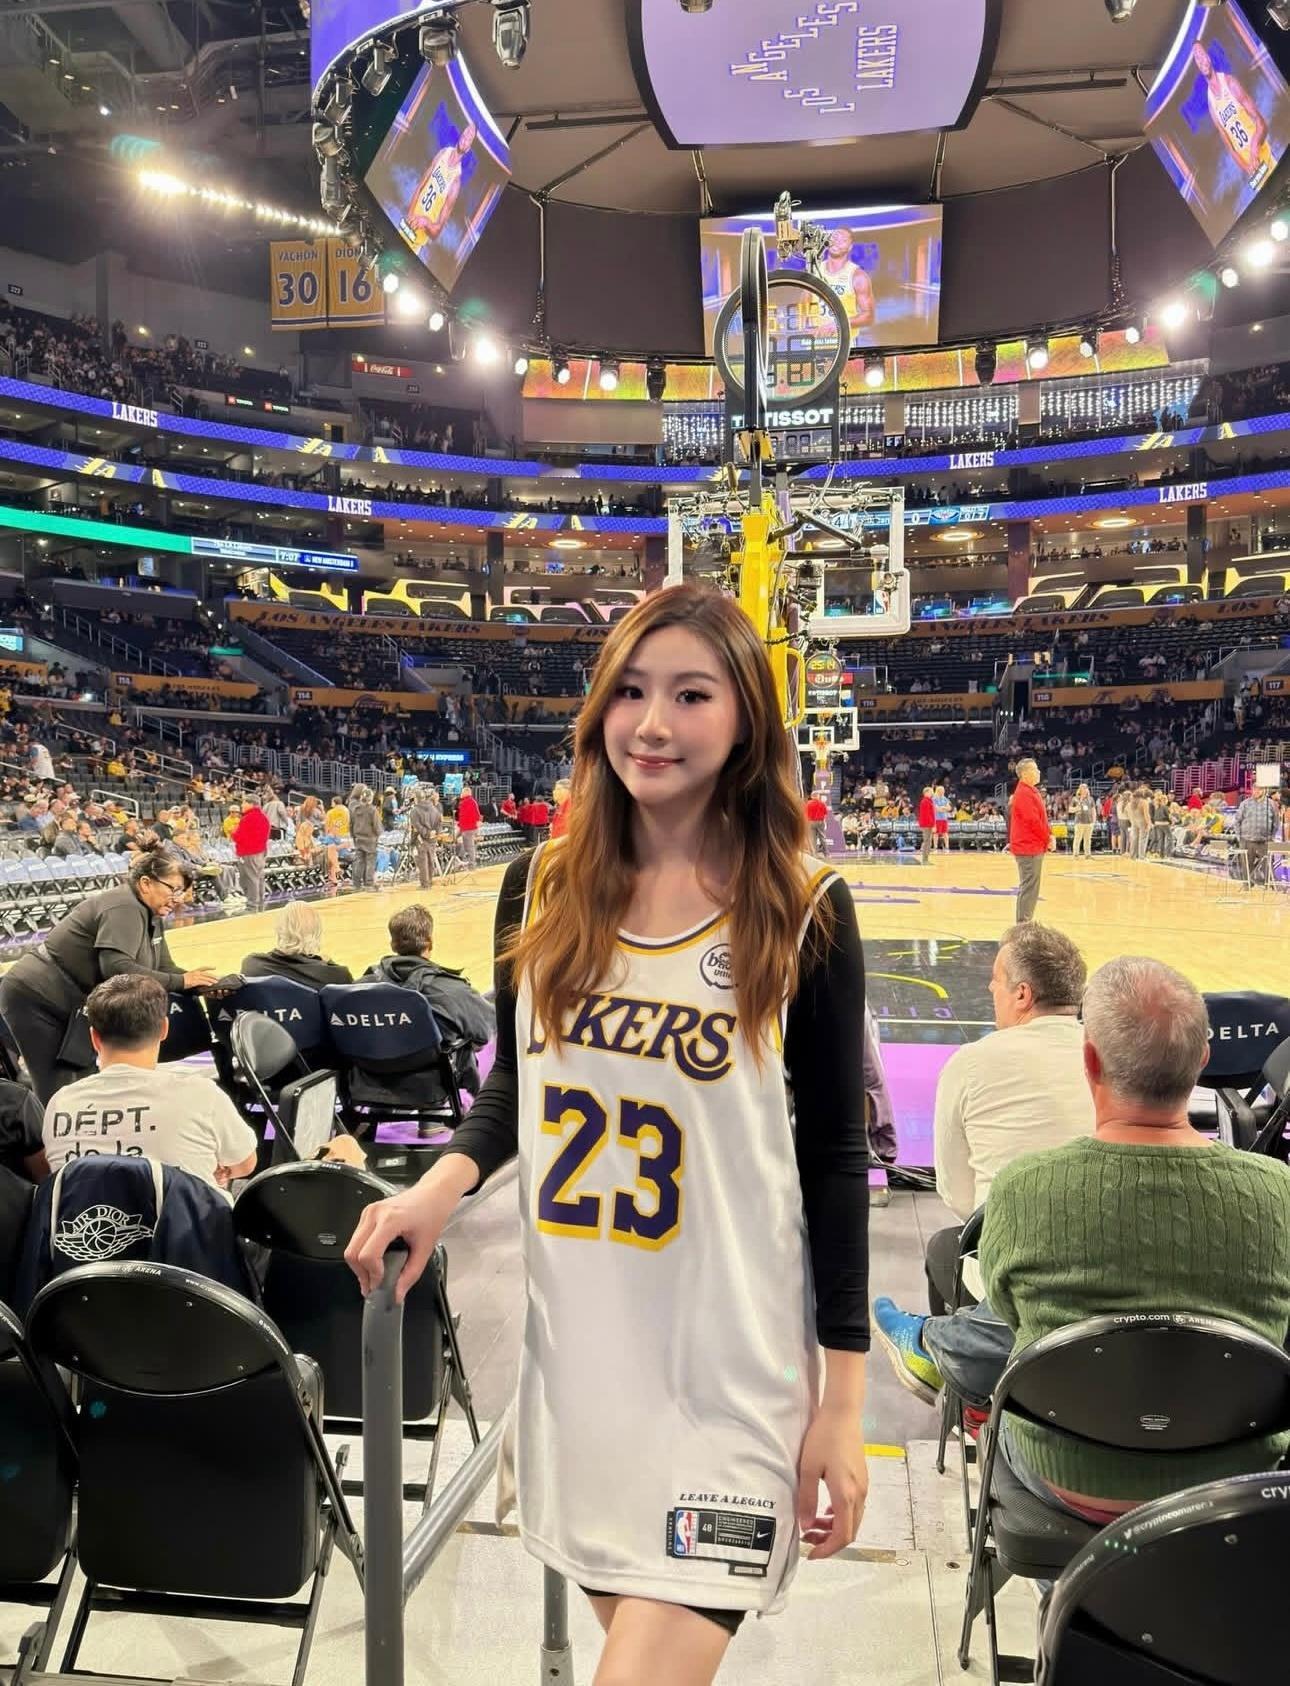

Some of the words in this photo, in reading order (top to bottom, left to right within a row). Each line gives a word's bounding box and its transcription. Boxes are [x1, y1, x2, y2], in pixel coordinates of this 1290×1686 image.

[856, 25, 897, 90] LAKERS
[1229, 120, 1249, 148] 36
[280, 249, 319, 262] VACHON
[278, 271, 319, 307] 30
[338, 268, 373, 304] 16
[111, 401, 159, 428] LAKERS
[765, 408, 834, 427] TISSOT
[950, 451, 995, 470] LAKERS
[1159, 482, 1208, 503] LAKERS
[327, 494, 372, 516] LAKERS
[347, 1011, 412, 1027] DELTA
[53, 1103, 157, 1138] DÉPT.
[536, 1080, 686, 1252] 23
[71, 1212, 91, 1234] AIR
[95, 1206, 130, 1226] DIOR
[1113, 1312, 1170, 1324] crypto.com
[680, 1493, 719, 1503] LEAVE
[720, 1495, 730, 1504] A
[732, 1495, 777, 1510] LEGACY
